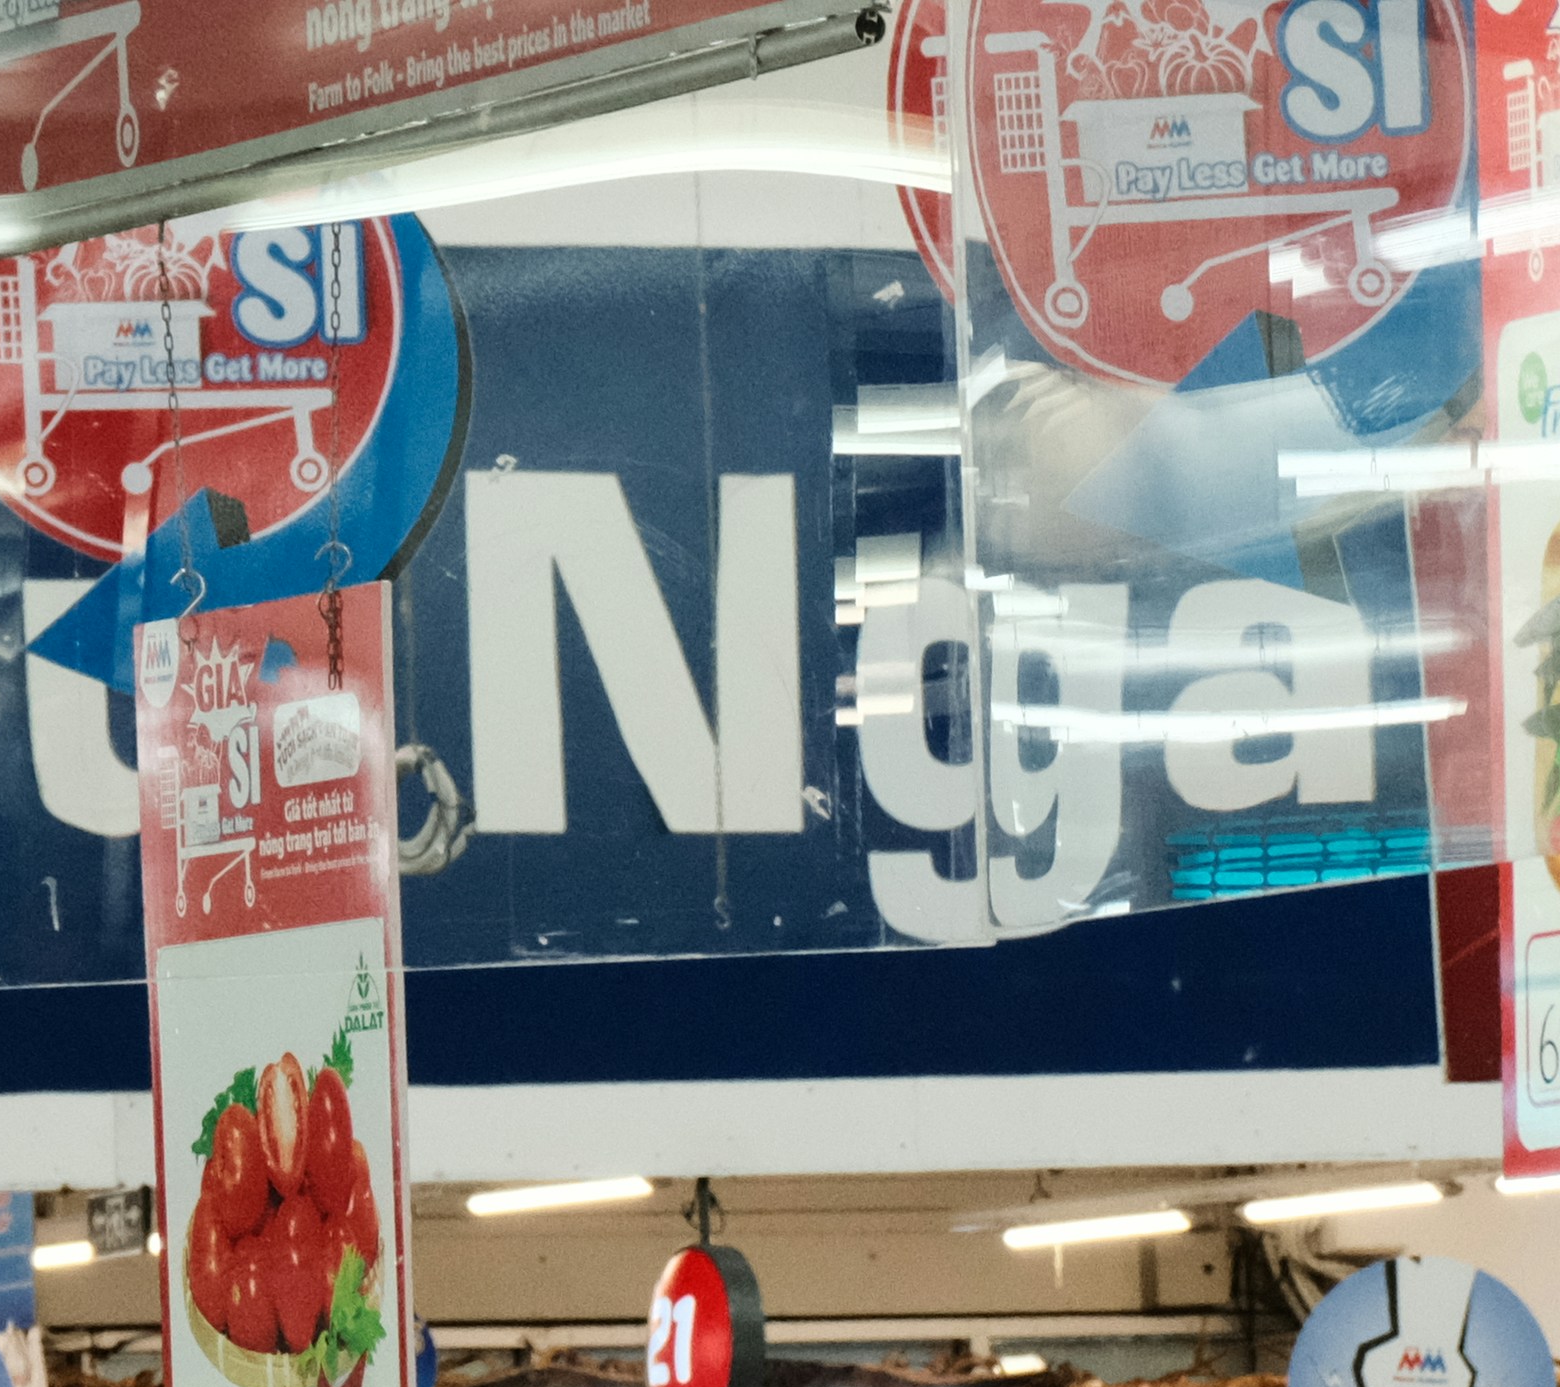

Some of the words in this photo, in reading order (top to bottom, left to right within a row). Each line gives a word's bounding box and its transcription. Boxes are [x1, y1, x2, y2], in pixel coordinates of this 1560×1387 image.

[308, 80, 342, 113] Farm
[343, 73, 360, 102] to
[364, 62, 394, 96] Folk
[407, 52, 443, 87] Bring
[447, 44, 470, 75] the
[474, 38, 505, 68] best
[509, 31, 550, 67] prices
[554, 20, 566, 46] in
[571, 15, 594, 43] the
[598, 3, 651, 36] market
[1116, 161, 1173, 199] Pay
[1179, 157, 1246, 190] Less
[1254, 152, 1303, 184] Get
[1312, 151, 1389, 181] More
[83, 359, 136, 391] Pay
[205, 353, 254, 381] Get
[258, 353, 327, 380] More
[647, 1295, 696, 1385] 21
